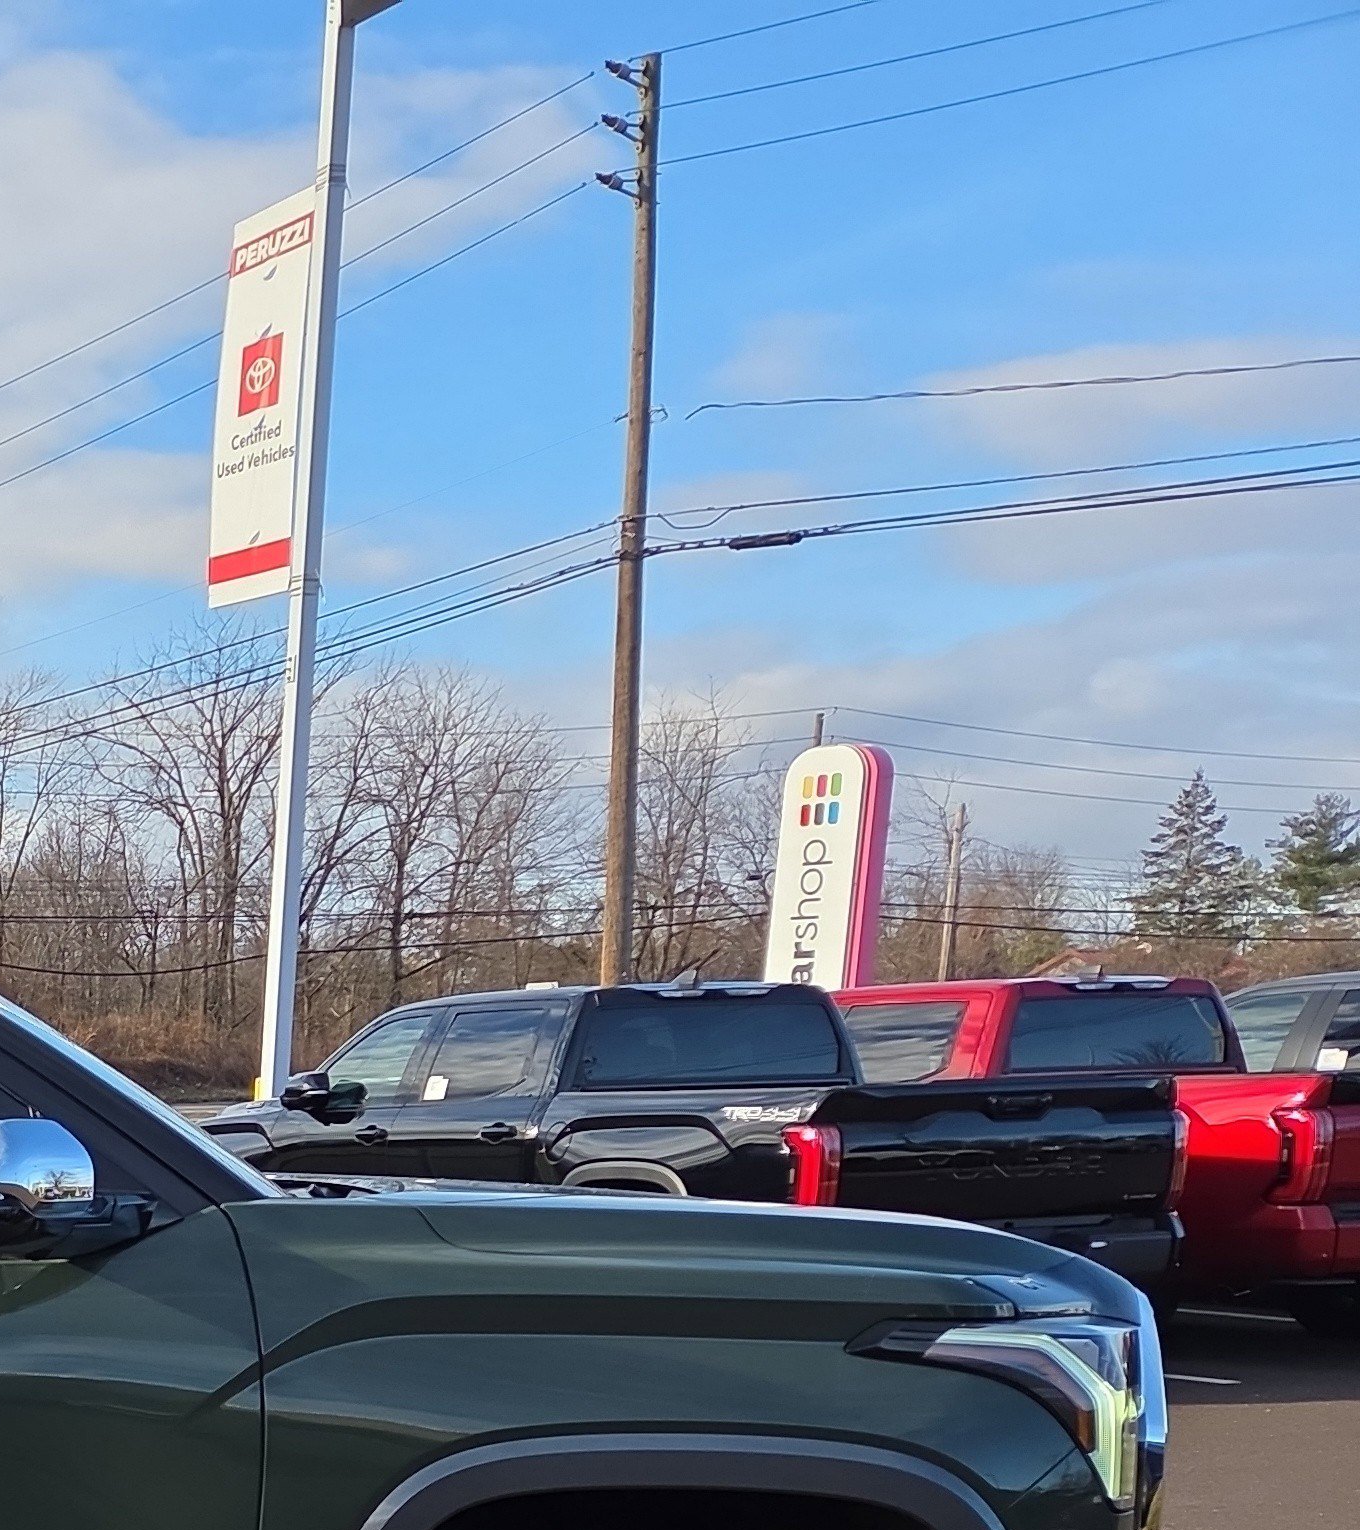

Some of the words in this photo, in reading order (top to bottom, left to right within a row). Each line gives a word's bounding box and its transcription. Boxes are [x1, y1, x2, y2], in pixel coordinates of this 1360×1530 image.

[235, 217, 311, 274] PERUZZI
[231, 419, 282, 450] Certified
[217, 454, 245, 478] Used
[247, 444, 296, 469] Vehicles
